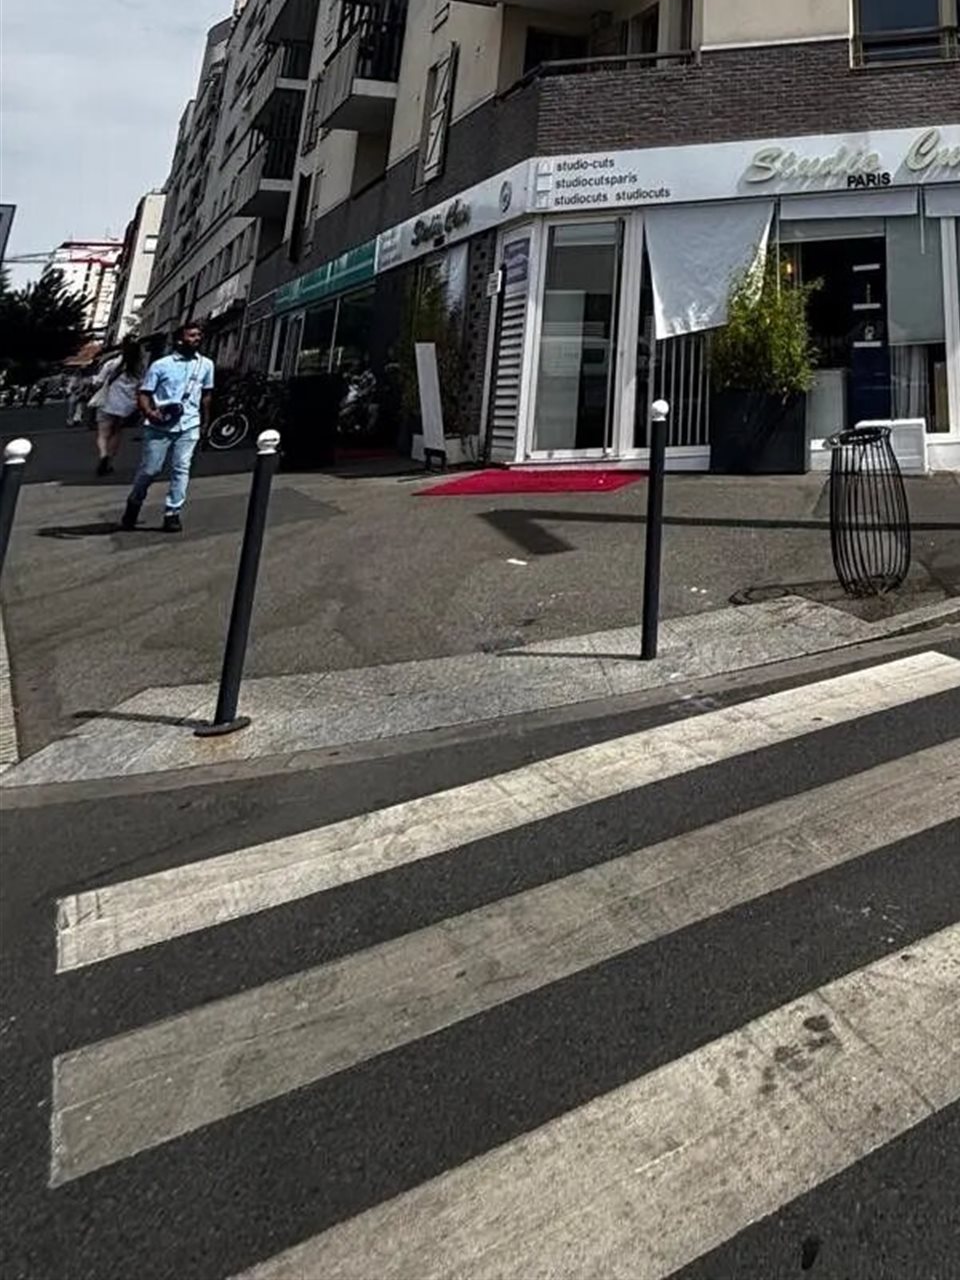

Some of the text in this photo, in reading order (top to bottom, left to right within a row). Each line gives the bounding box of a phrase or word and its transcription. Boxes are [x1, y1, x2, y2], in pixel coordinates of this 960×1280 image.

[555, 172, 638, 189] studiocutsparis
[847, 172, 891, 188] PARIS
[554, 187, 671, 206] studiocuts studiocuts
